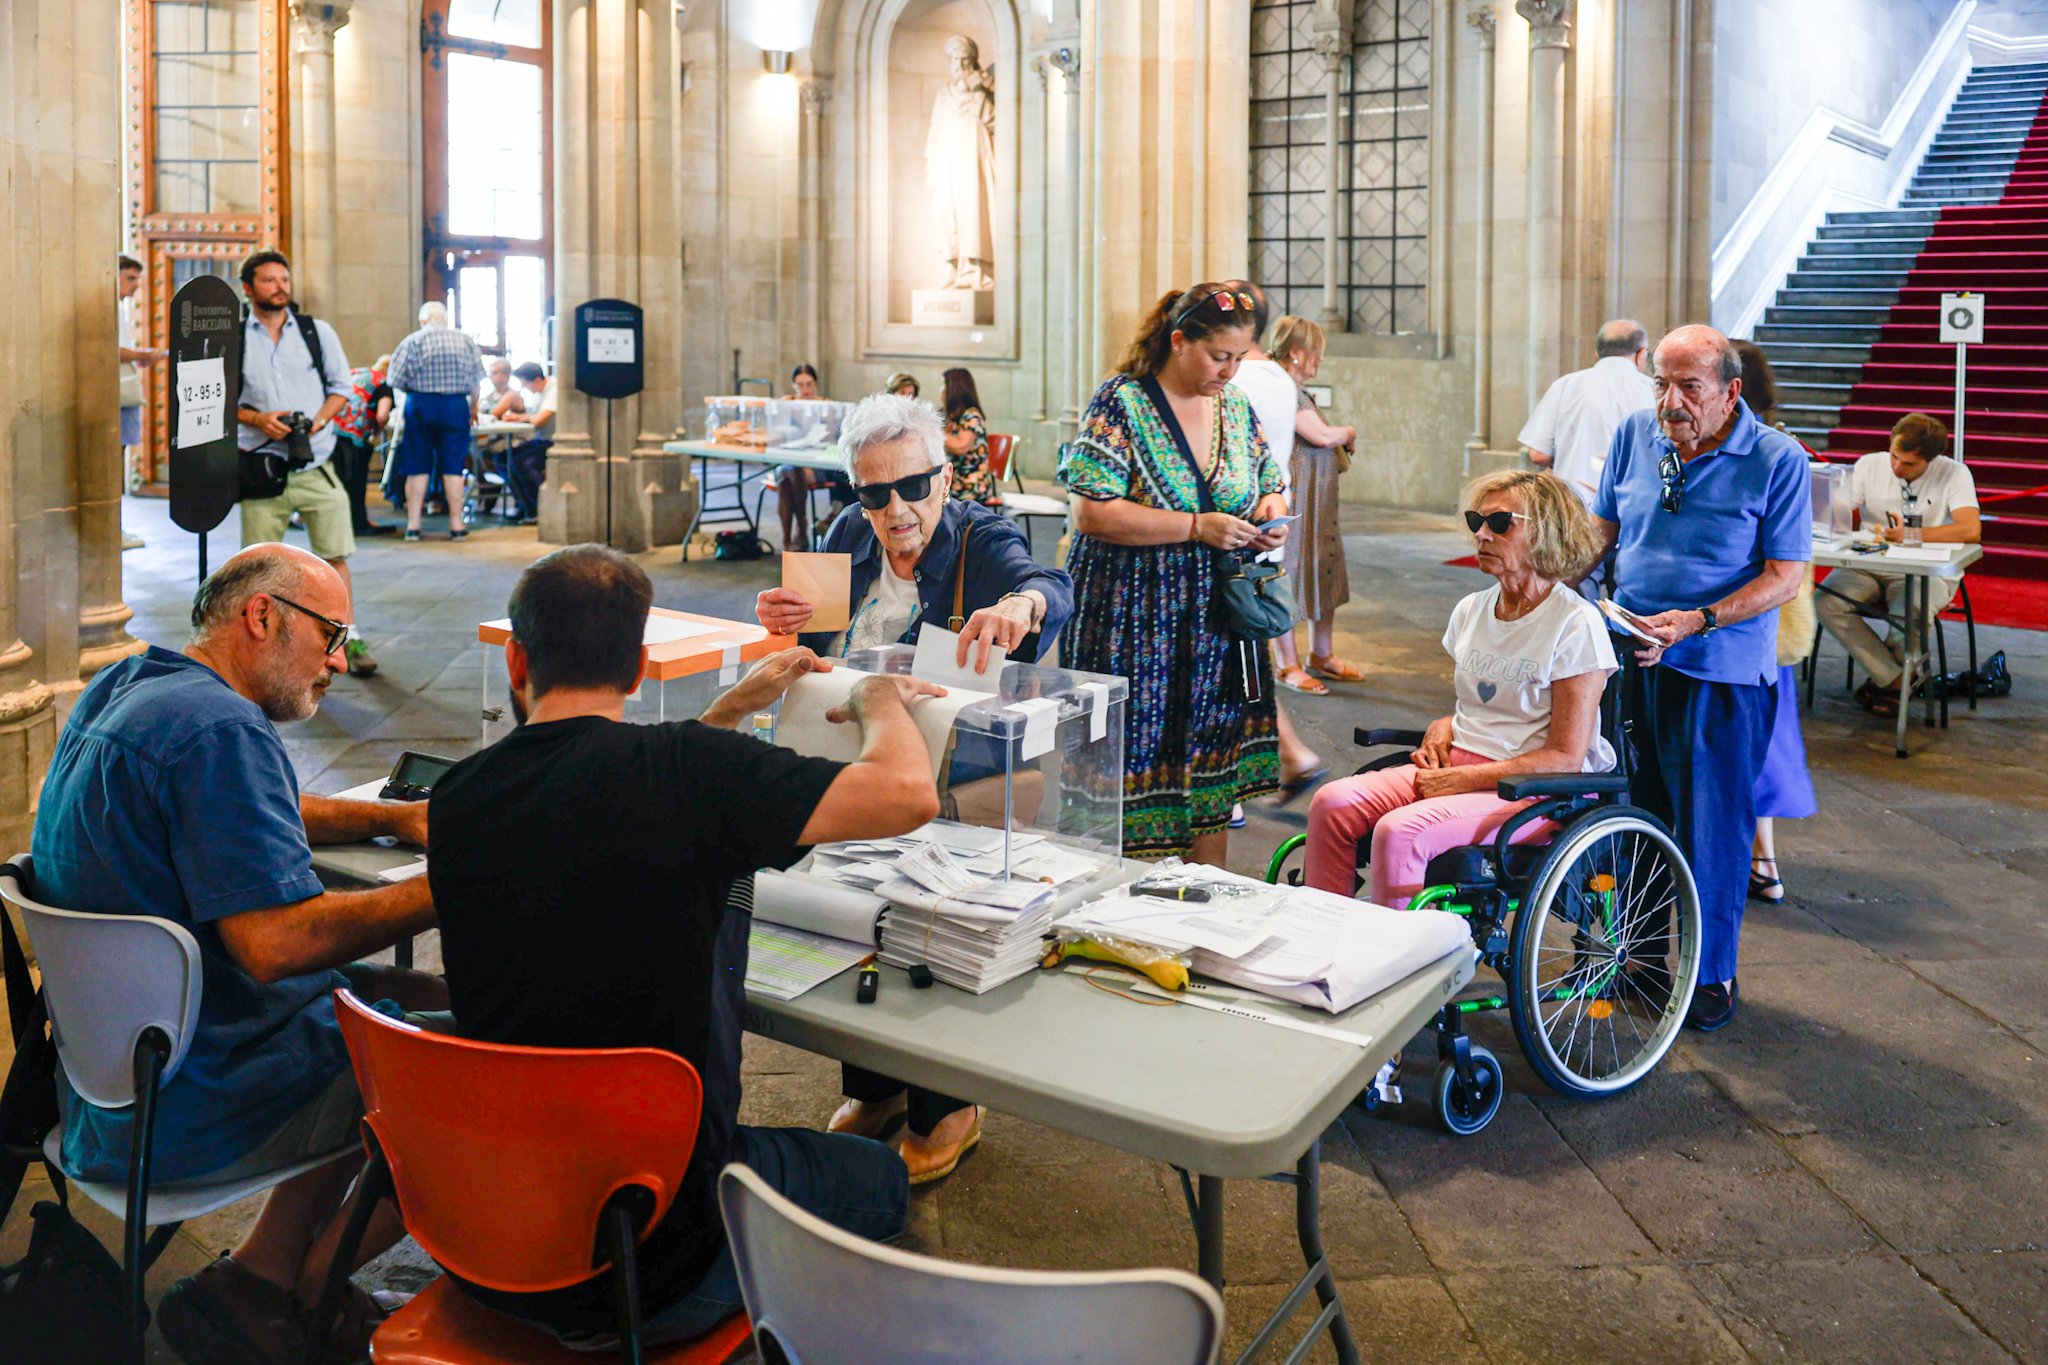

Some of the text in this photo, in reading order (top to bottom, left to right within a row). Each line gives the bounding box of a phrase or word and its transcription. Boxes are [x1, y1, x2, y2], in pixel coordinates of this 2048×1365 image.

[193, 318, 231, 331] BARCELONA
[200, 384, 210, 400] 95
[216, 382, 222, 397] B
[1457, 646, 1539, 683] AMOUR
